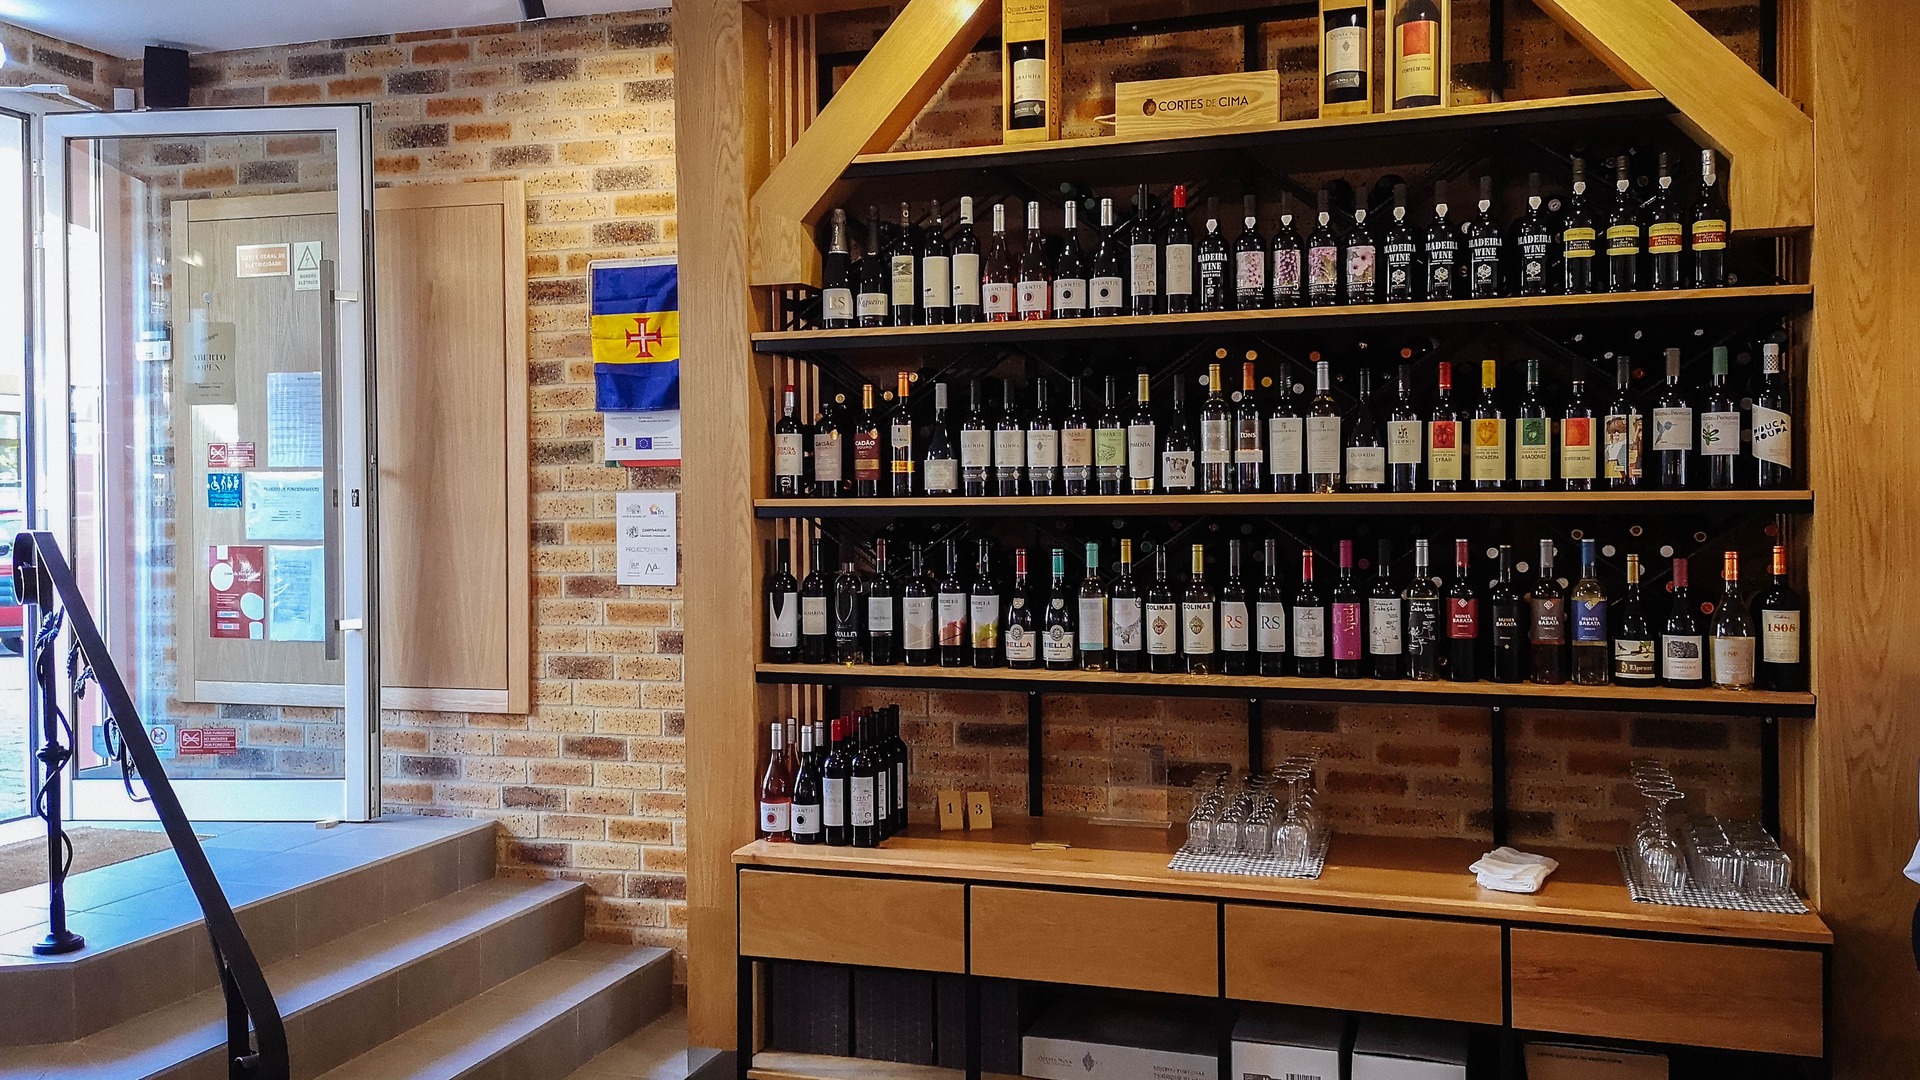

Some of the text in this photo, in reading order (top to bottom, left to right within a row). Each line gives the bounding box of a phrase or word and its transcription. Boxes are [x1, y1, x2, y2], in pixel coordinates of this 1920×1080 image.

[1158, 95, 1249, 112] CORTES DE CIMA
[1425, 240, 1458, 252] MADEIRA
[1468, 237, 1502, 249] MADEIRA
[1517, 234, 1552, 246] MADEIRA
[1384, 243, 1416, 254] MADEIRA
[1474, 247, 1497, 257] WINE
[1523, 244, 1546, 254] WINE
[1389, 253, 1411, 262] WINE
[1431, 250, 1453, 260] WINE
[1201, 262, 1222, 271] WINE
[1293, 280, 1299, 291] 5
[1328, 277, 1335, 287] 5
[1366, 276, 1373, 288] 5
[829, 296, 846, 310] RS
[193, 353, 226, 362] ABERTO
[197, 363, 221, 372] OPEN
[1753, 418, 1787, 436] POUCA
[1754, 426, 1788, 443] ROUPA
[1224, 615, 1243, 629] RS
[1261, 615, 1281, 630] RS
[1767, 622, 1796, 633] 1808
[947, 802, 954, 814] 1
[975, 803, 983, 815] 3
